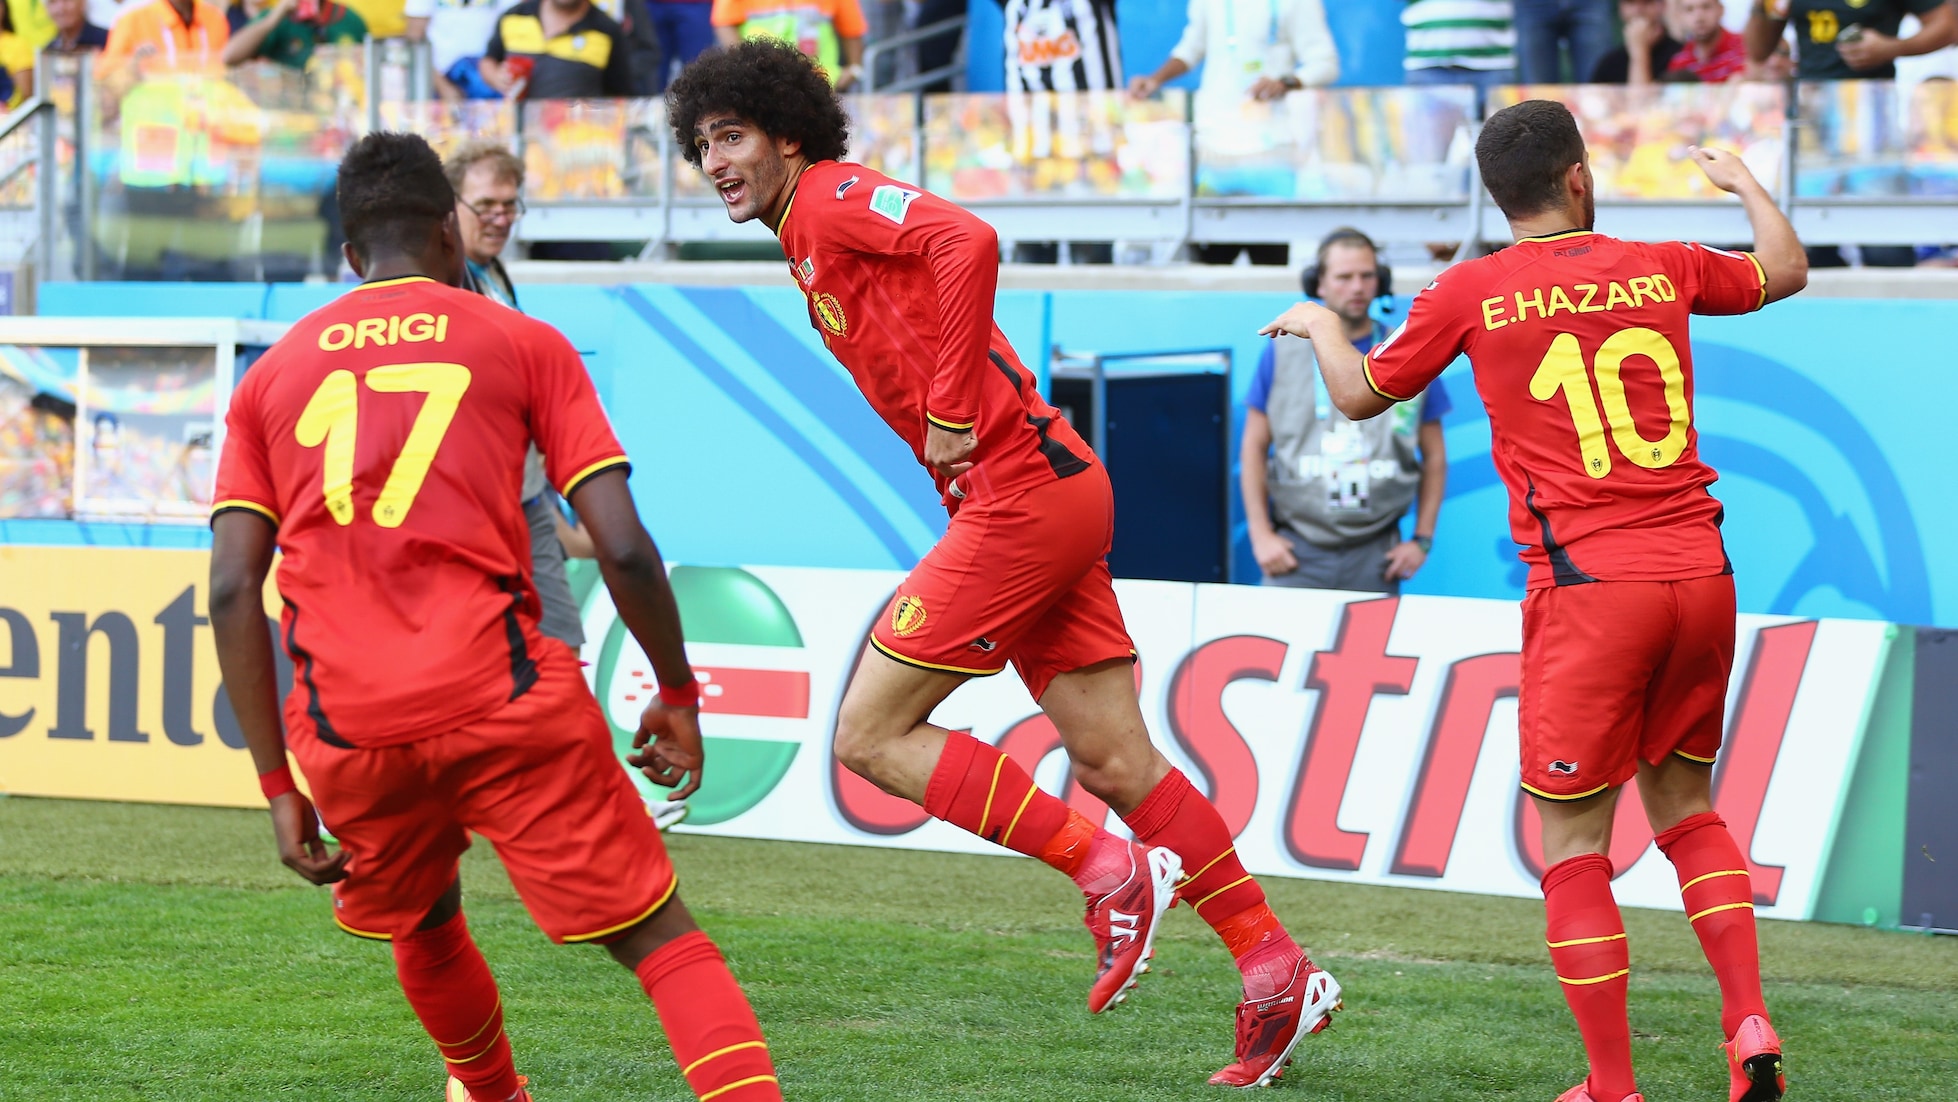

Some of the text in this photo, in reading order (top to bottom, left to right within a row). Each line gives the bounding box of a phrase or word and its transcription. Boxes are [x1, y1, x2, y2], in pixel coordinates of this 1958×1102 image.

[318, 313, 448, 351] ORIGI
[1481, 273, 1677, 331] E.HAZARD
[294, 362, 472, 528] 17
[1529, 327, 1690, 479] 10
[831, 596, 1818, 906] strl
